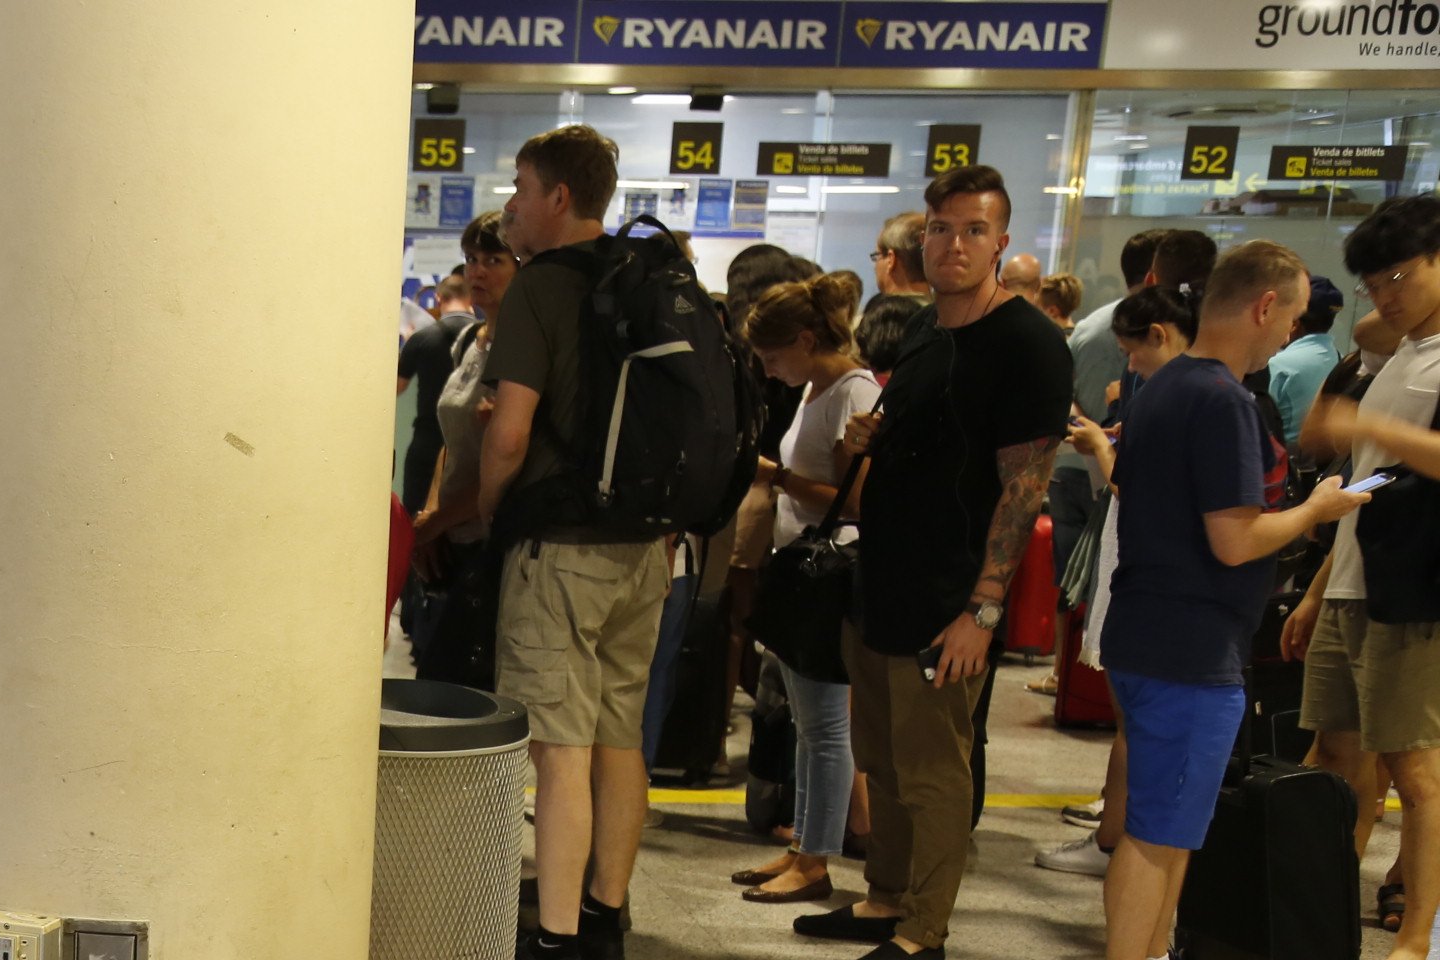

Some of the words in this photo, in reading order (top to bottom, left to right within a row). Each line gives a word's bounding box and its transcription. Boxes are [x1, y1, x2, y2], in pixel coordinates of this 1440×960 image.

[622, 18, 828, 49] RYANAIR
[884, 21, 1091, 52] RYANAIR
[1255, 0, 1440, 48] groundfo
[1358, 42, 1382, 57] We
[419, 137, 459, 168] 55
[675, 140, 715, 170] 54
[828, 145, 839, 154] de
[931, 143, 971, 173] 53
[1189, 145, 1229, 175] 52
[1312, 158, 1333, 167] Ticket
[1313, 147, 1341, 157] Venda
[1342, 147, 1354, 157] de
[1355, 147, 1386, 158] bitllets
[1311, 167, 1335, 177] Venta
[1336, 167, 1347, 177] de
[1348, 167, 1379, 177] billetes
